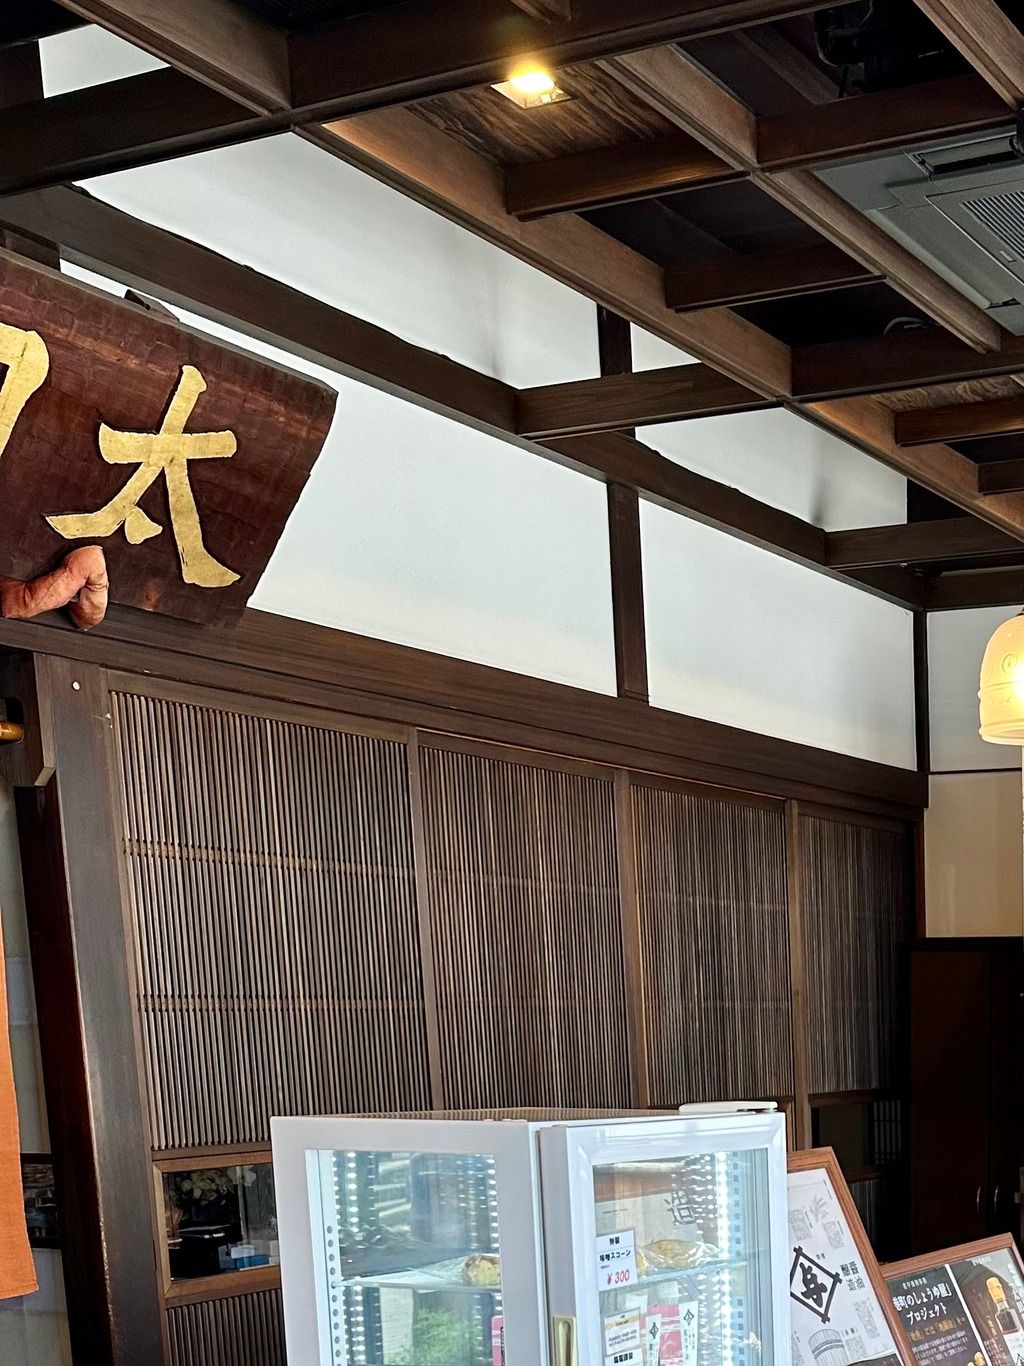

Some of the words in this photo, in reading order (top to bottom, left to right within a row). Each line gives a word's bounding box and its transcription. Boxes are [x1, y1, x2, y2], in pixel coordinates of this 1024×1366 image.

[906, 1302, 948, 1326] プロジェクト
